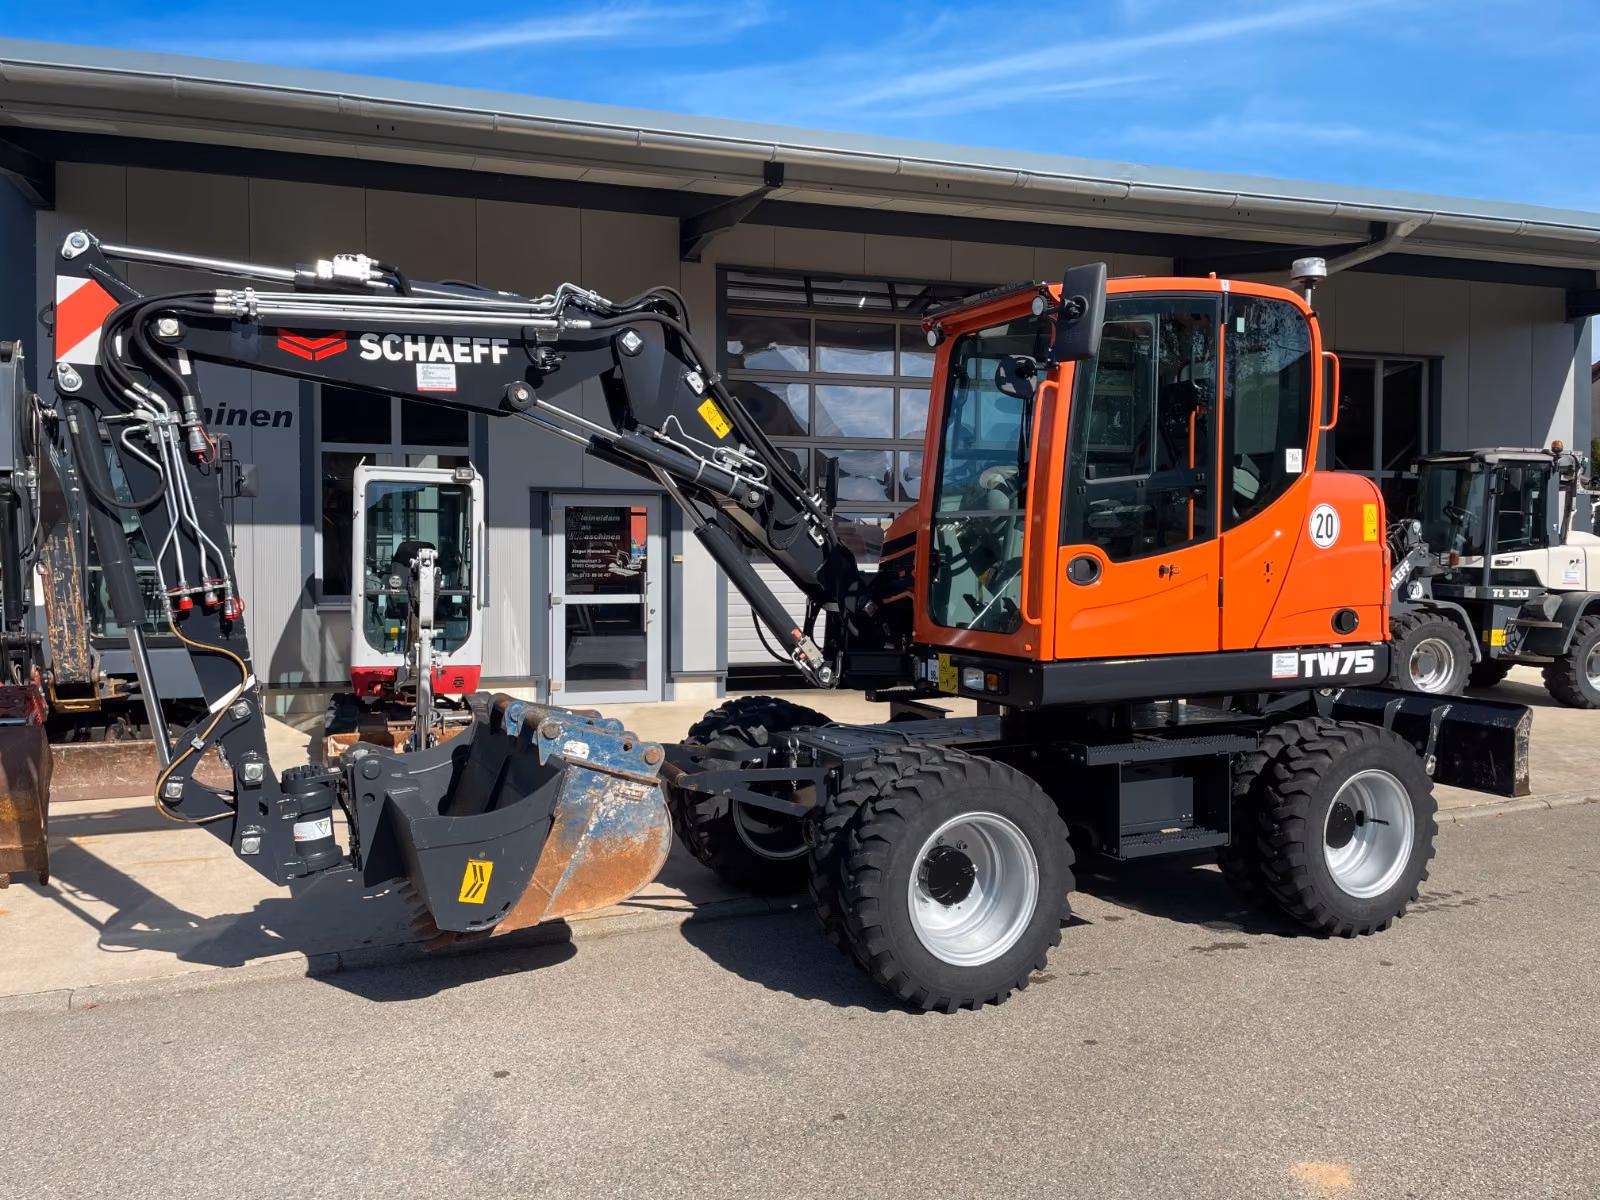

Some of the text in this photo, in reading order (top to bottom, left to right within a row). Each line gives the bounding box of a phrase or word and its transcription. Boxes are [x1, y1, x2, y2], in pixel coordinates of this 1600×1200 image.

[360, 333, 509, 364] SCHAEFF
[1316, 513, 1334, 539] 20
[1410, 584, 1420, 596] 20
[1300, 649, 1375, 678] TW75
